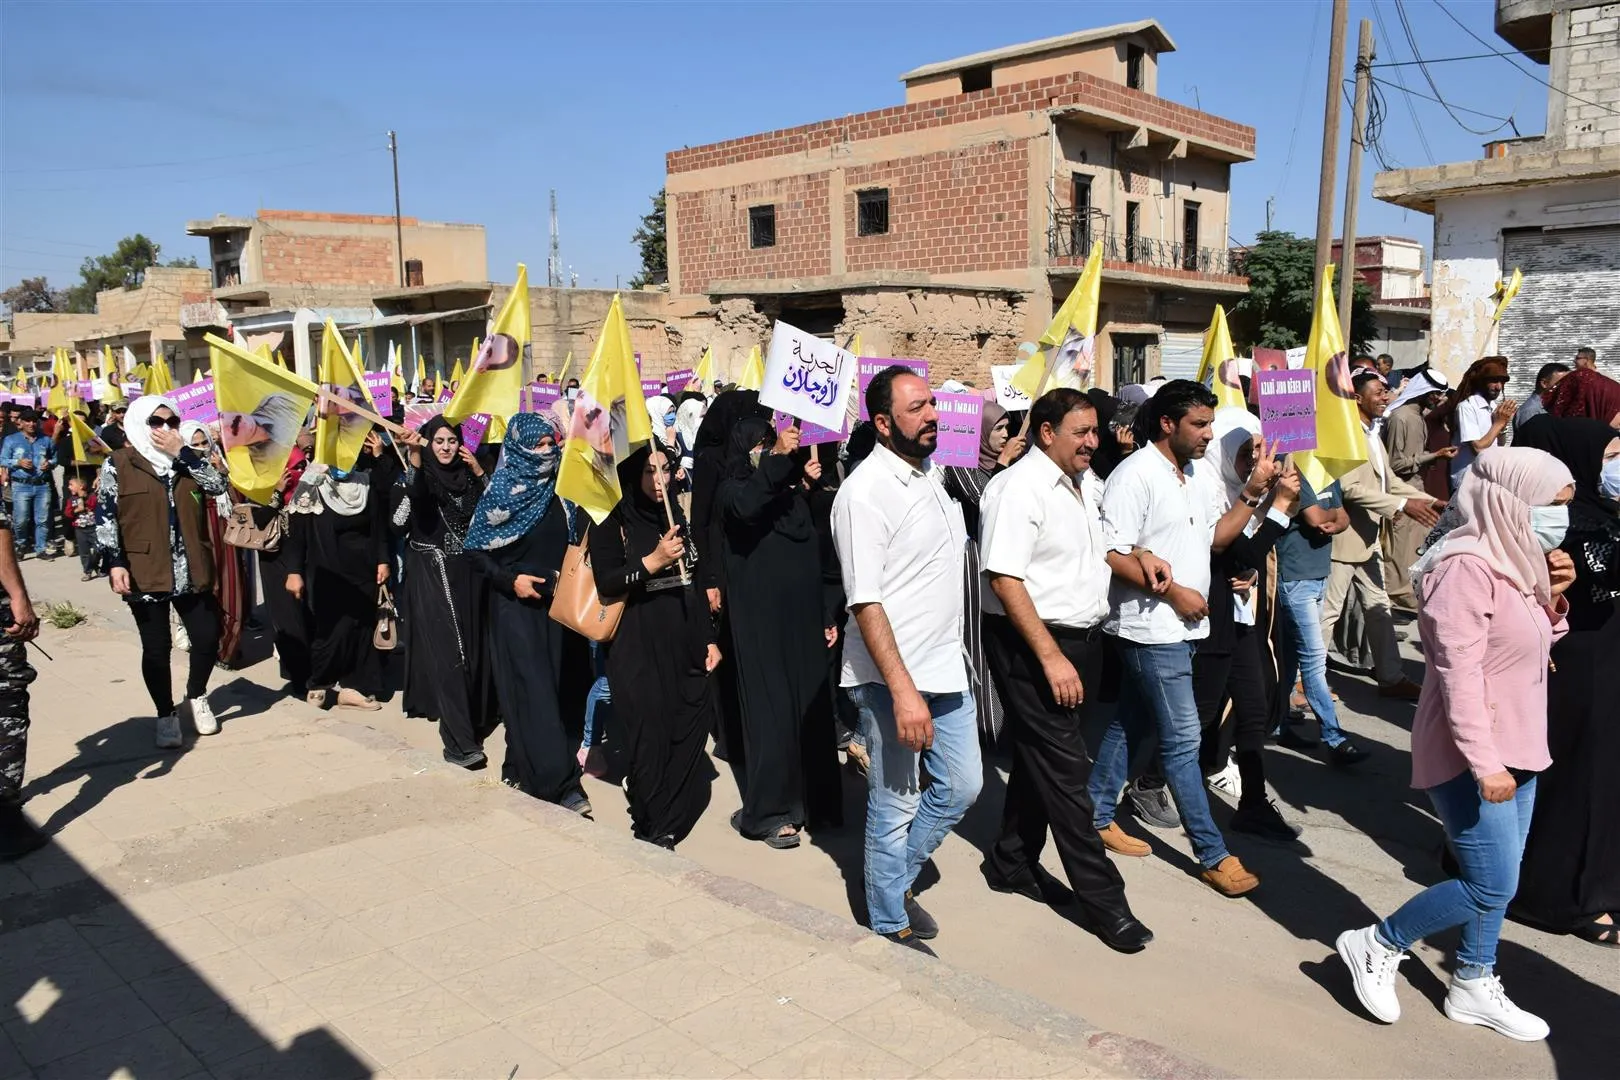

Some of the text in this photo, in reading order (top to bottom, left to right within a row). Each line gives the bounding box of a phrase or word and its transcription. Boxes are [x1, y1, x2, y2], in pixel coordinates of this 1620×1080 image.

[1302, 380, 1312, 393] APO
[954, 399, 979, 415] ÎMRALI
[1365, 951, 1374, 974] FILA
